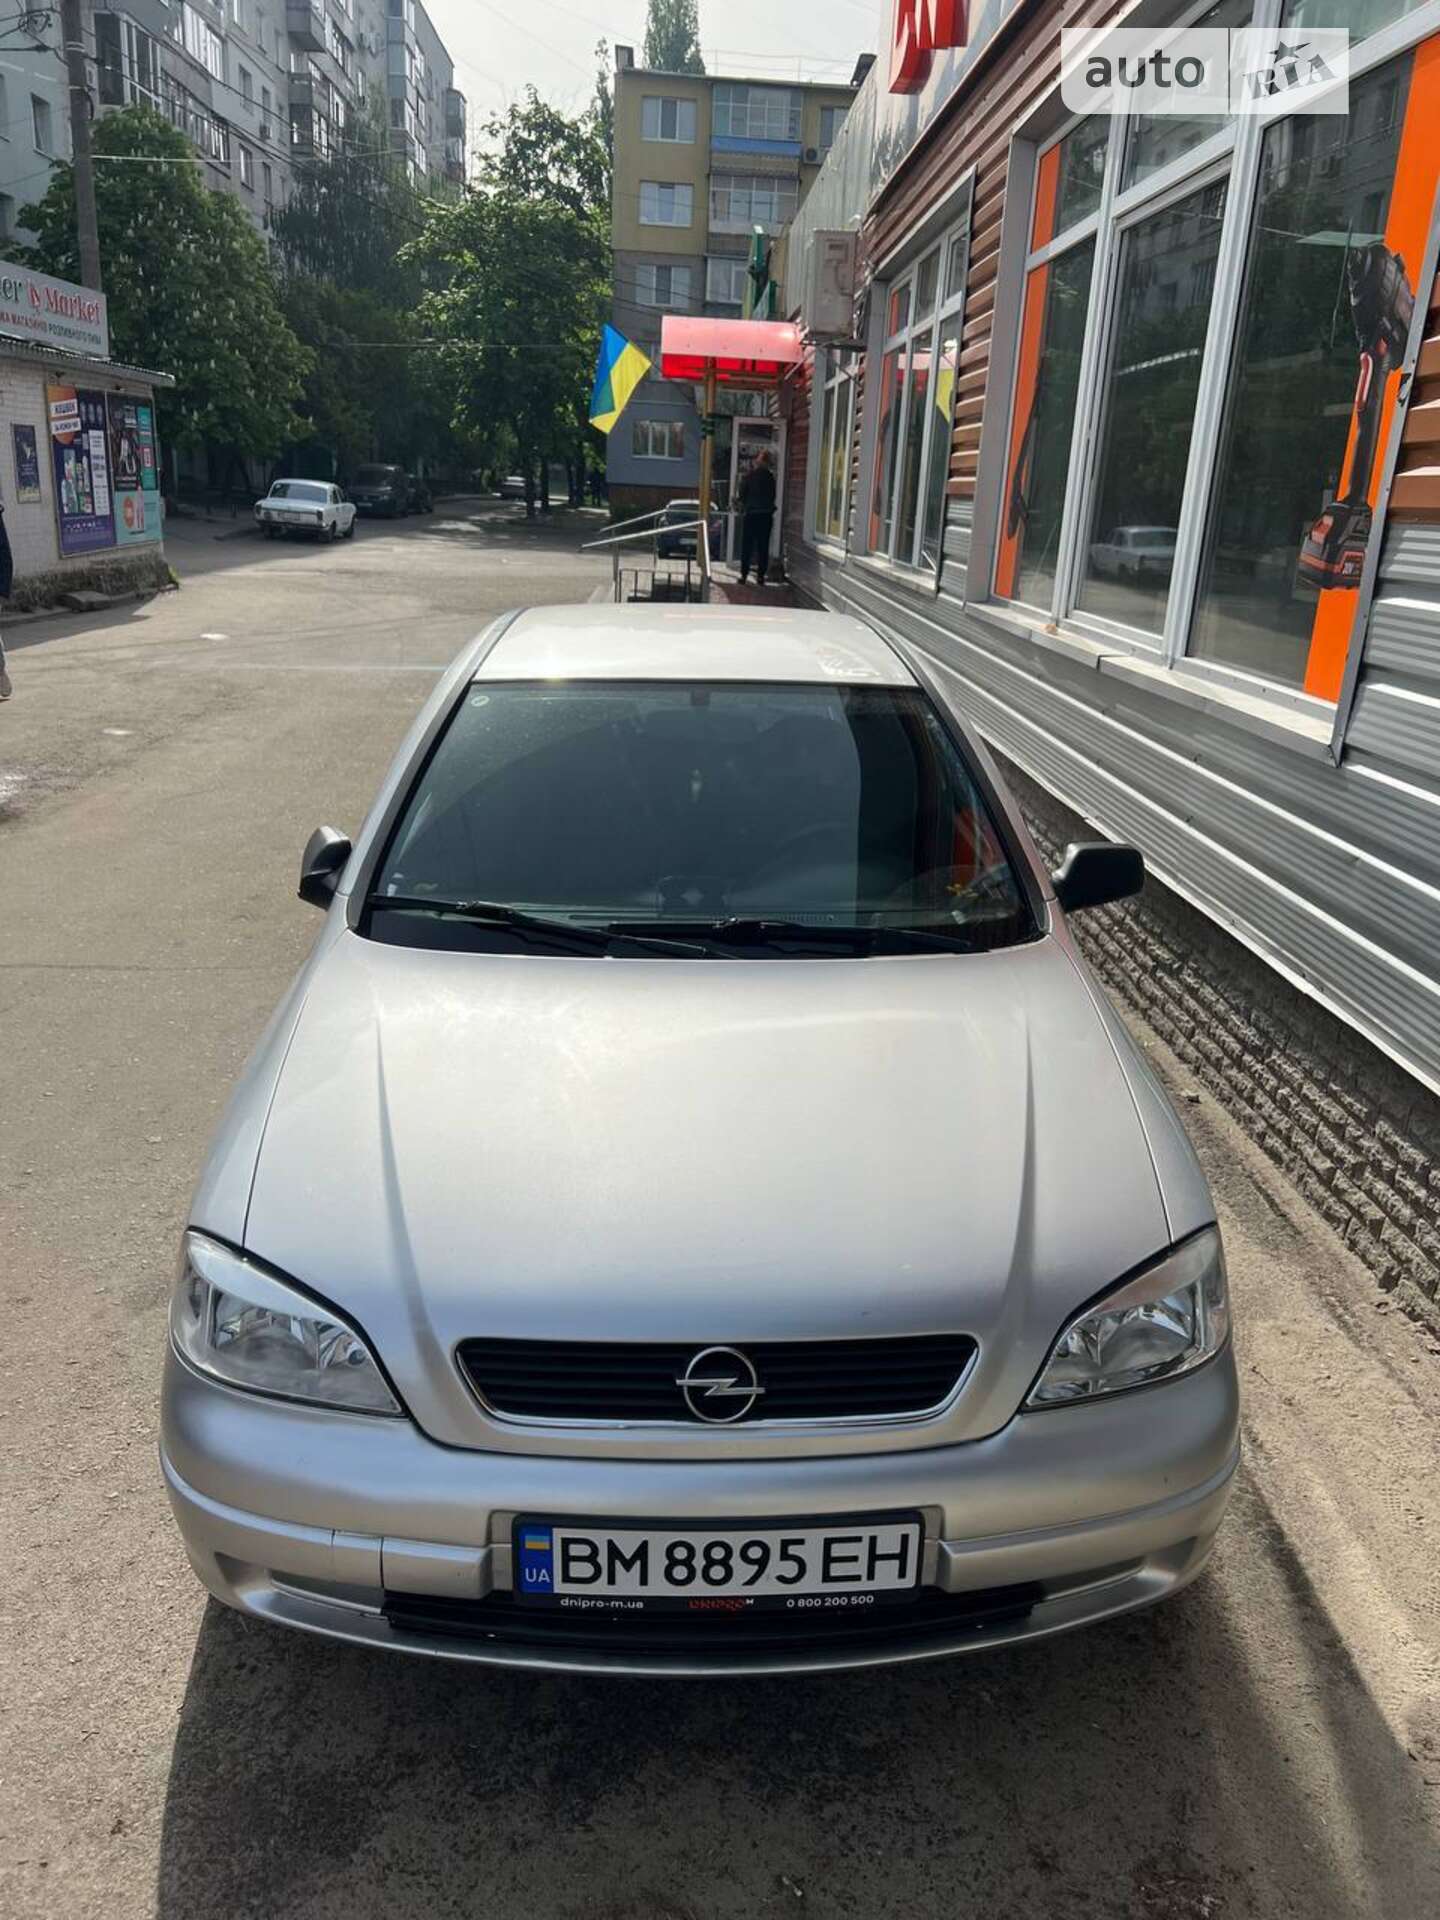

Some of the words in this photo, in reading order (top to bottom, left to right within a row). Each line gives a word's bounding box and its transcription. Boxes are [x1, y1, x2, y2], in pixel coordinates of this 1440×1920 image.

[45, 287, 101, 325] Market
[561, 1537, 648, 1586] BM
[664, 1538, 807, 1586] 8895
[821, 1534, 910, 1583] EH
[525, 1568, 550, 1582] UA
[560, 1597, 644, 1609] dnipro-m.ua
[786, 1600, 795, 1608] 0
[798, 1598, 821, 1607] 800
[824, 1597, 848, 1607] 200
[850, 1595, 874, 1605] 500
